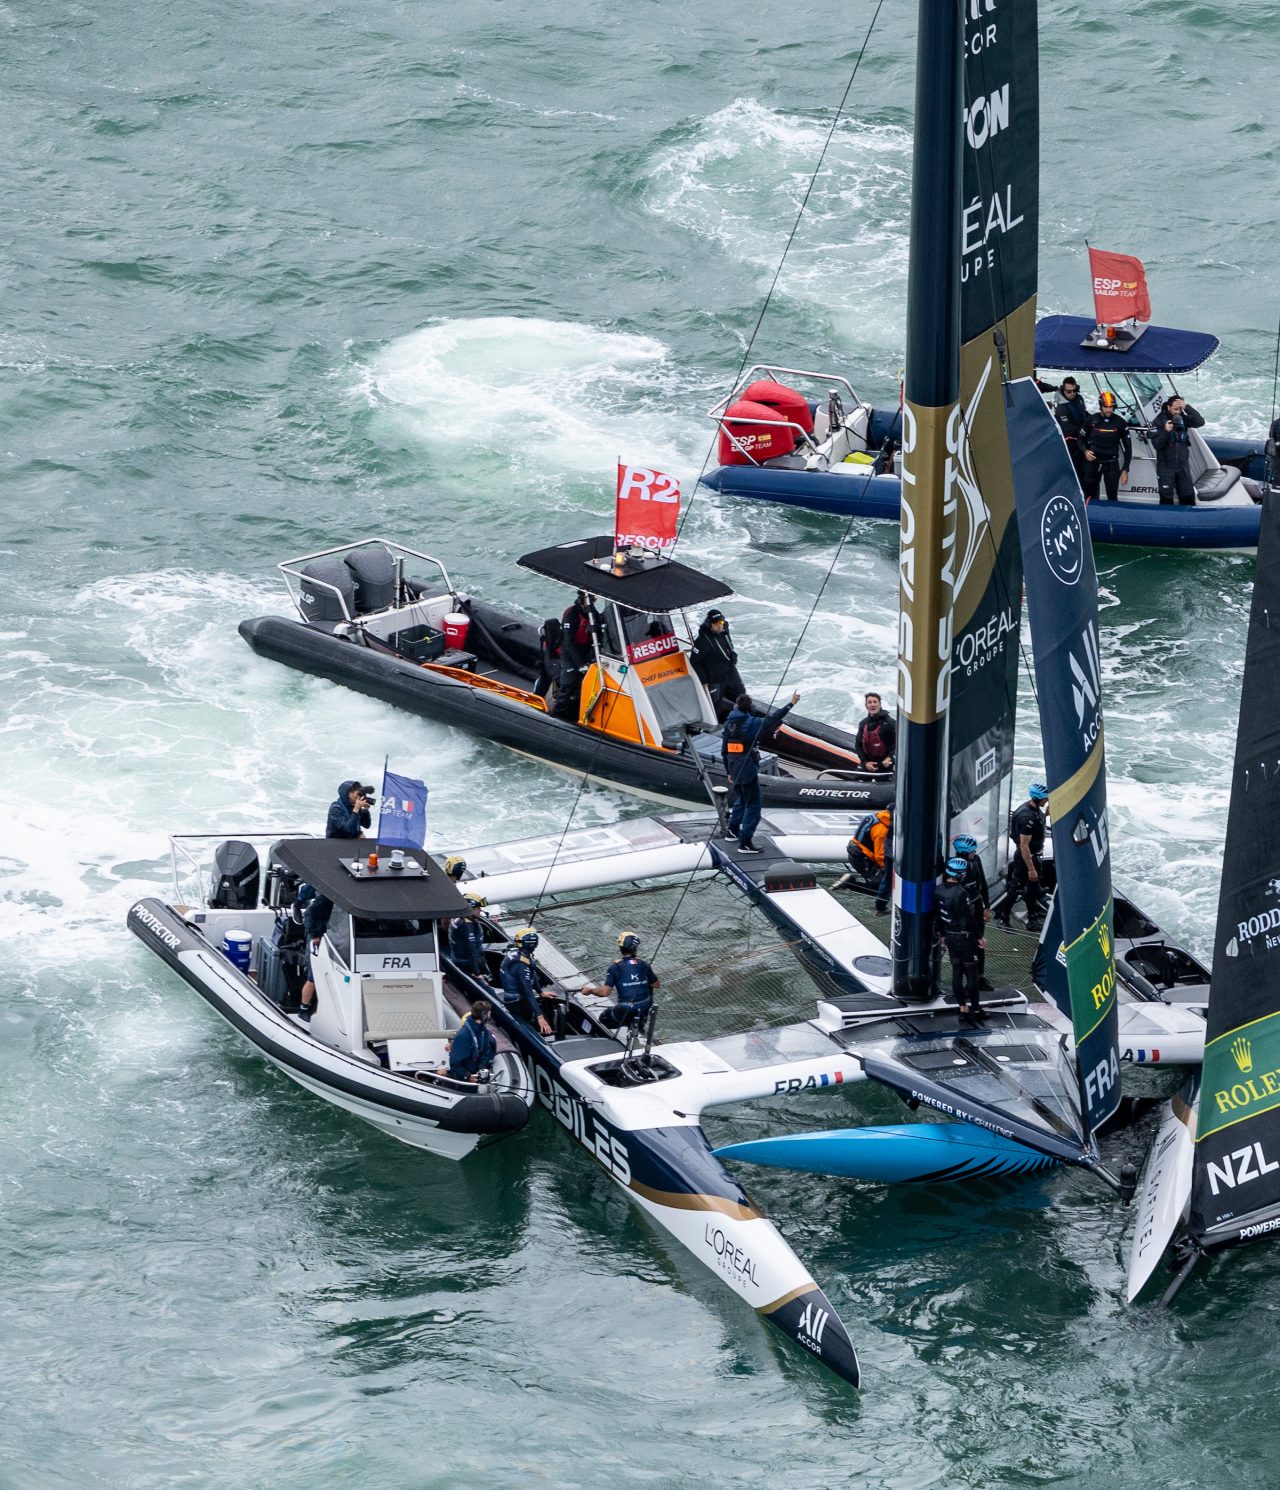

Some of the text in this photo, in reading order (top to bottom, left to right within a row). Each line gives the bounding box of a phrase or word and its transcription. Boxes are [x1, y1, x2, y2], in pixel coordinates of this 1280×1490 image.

[1094, 277, 1121, 290] ESP
[619, 466, 680, 504] R2
[1130, 486, 1160, 494] BERTH
[633, 636, 678, 659] RESCUE
[966, 641, 1005, 677] GROUPE
[641, 673, 657, 684] CHIEF
[800, 788, 870, 798] PROTECTOR
[131, 904, 181, 950] PROTECTOR
[382, 957, 411, 969] FRA
[772, 1075, 817, 1096] FRA
[1084, 1046, 1119, 1111] FRA
[912, 1090, 953, 1113] POWERED
[956, 1109, 967, 1120] BY
[1206, 1141, 1280, 1196] NZL
[1138, 1169, 1162, 1258] SOFITEL
[704, 1222, 760, 1288] L'ORÉAL
[717, 1257, 747, 1289] GROUPE
[798, 1332, 822, 1355] ACCOR
